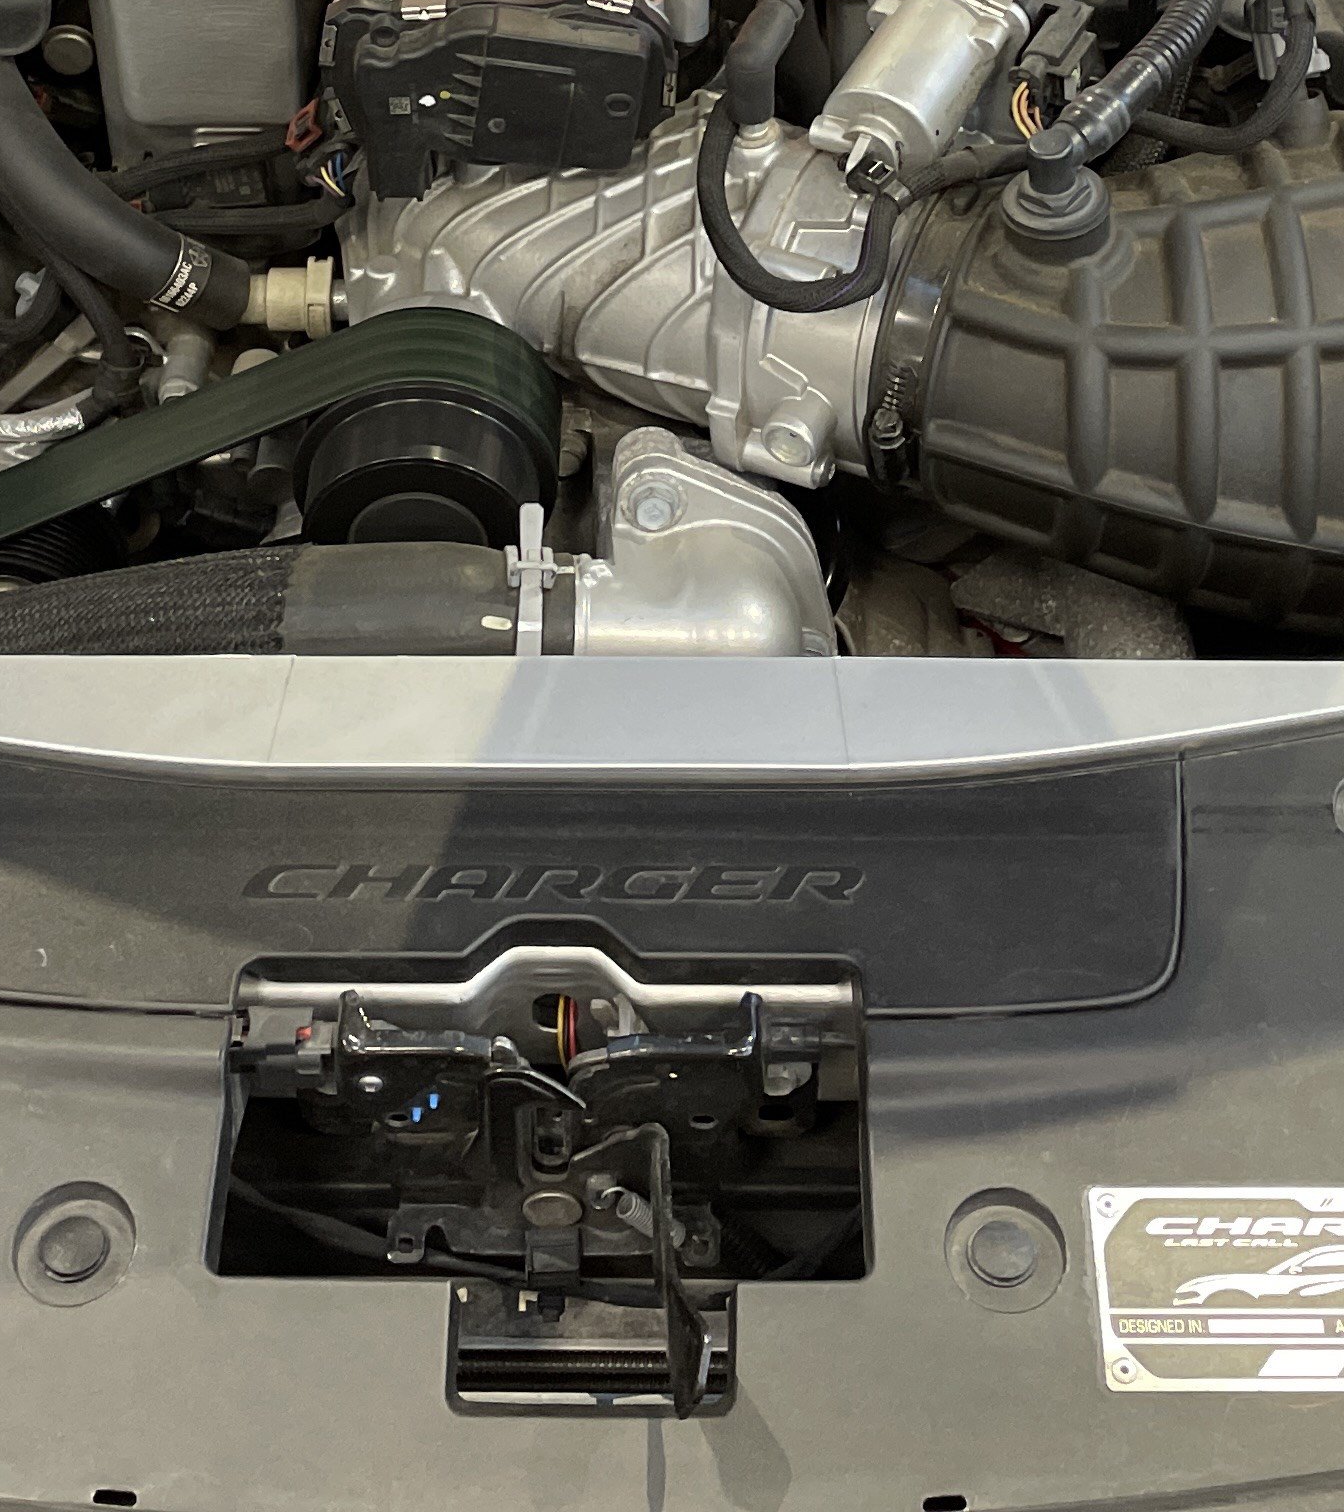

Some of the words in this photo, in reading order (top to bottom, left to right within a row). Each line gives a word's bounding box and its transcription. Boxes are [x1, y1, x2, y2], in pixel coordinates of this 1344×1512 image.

[241, 863, 869, 903] CHARGER
[1163, 1237, 1230, 1248] LAST
[1232, 1237, 1300, 1248] CALL
[1118, 1318, 1186, 1335] DESIGNED
